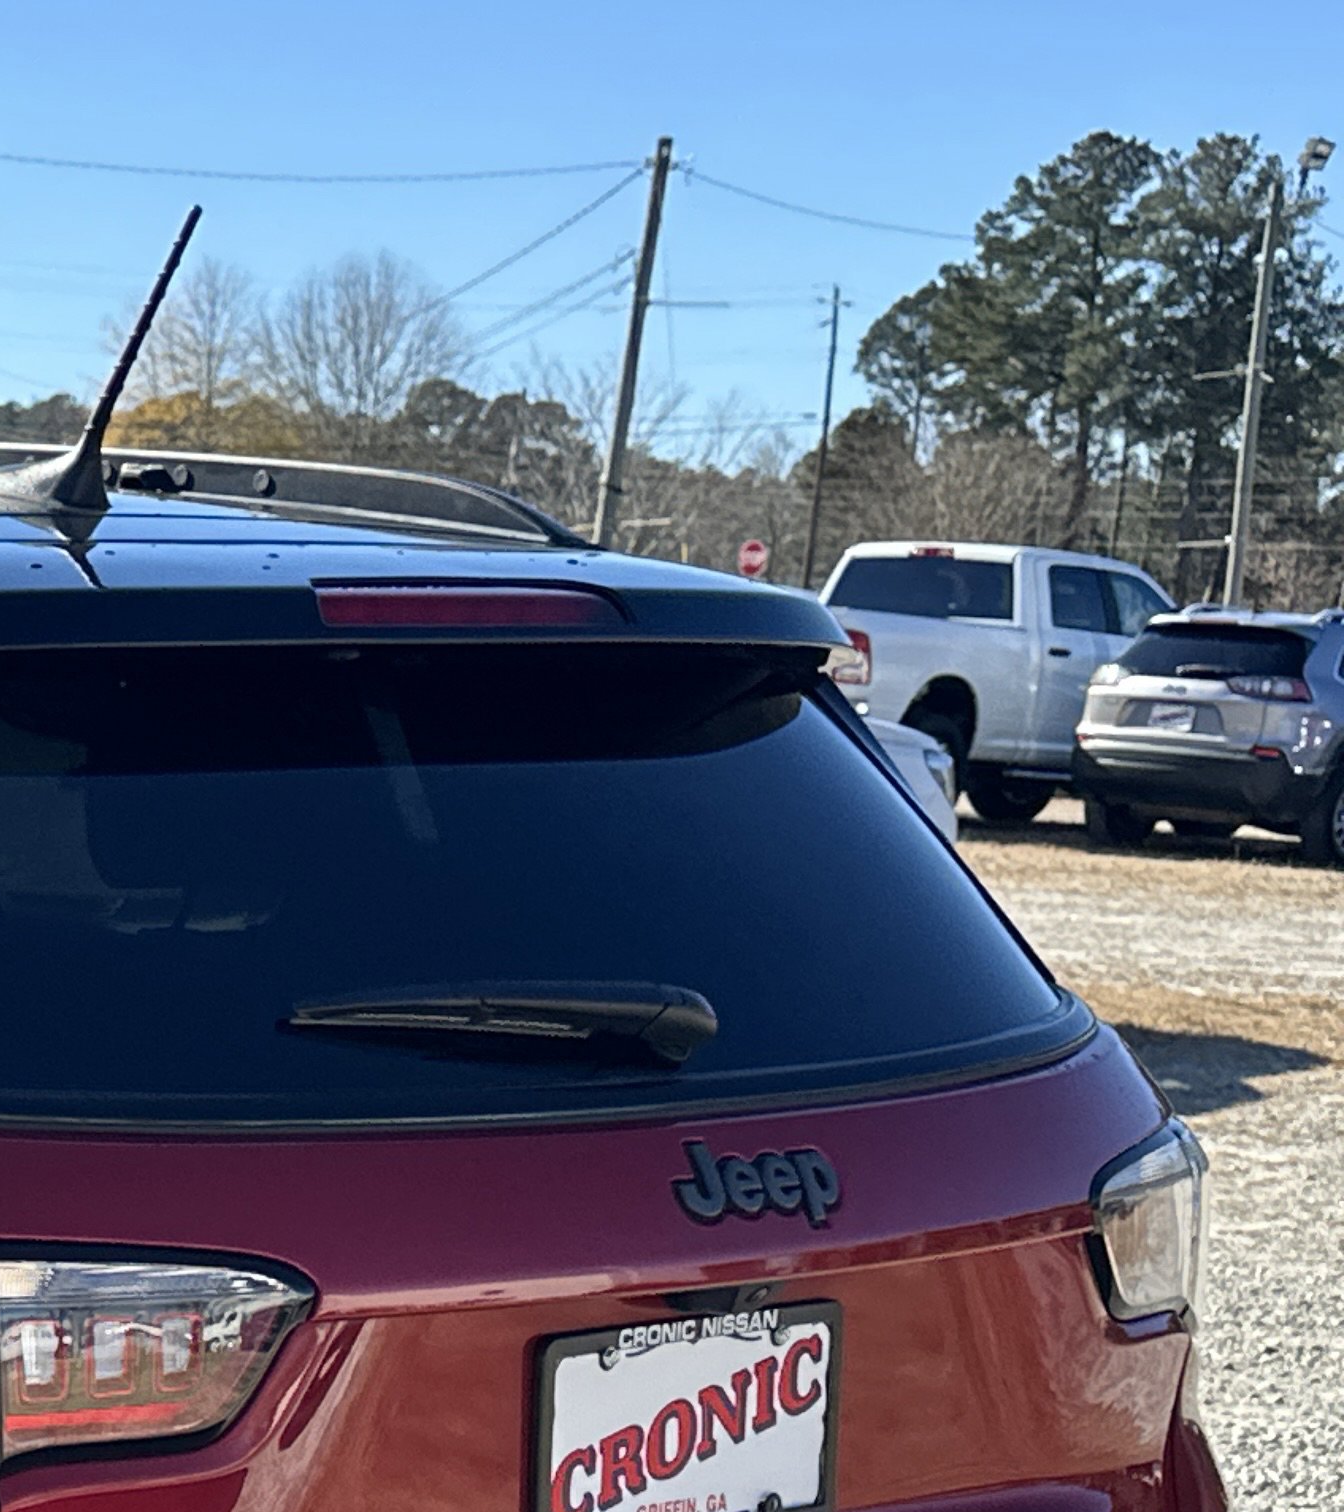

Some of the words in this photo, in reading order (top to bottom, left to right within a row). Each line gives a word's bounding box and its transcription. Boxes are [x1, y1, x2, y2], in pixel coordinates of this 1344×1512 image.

[670, 1136, 842, 1229] Jeep
[618, 1319, 697, 1350] CRONIC
[702, 1309, 779, 1338] NISSAN
[706, 1493, 727, 1512] GA
